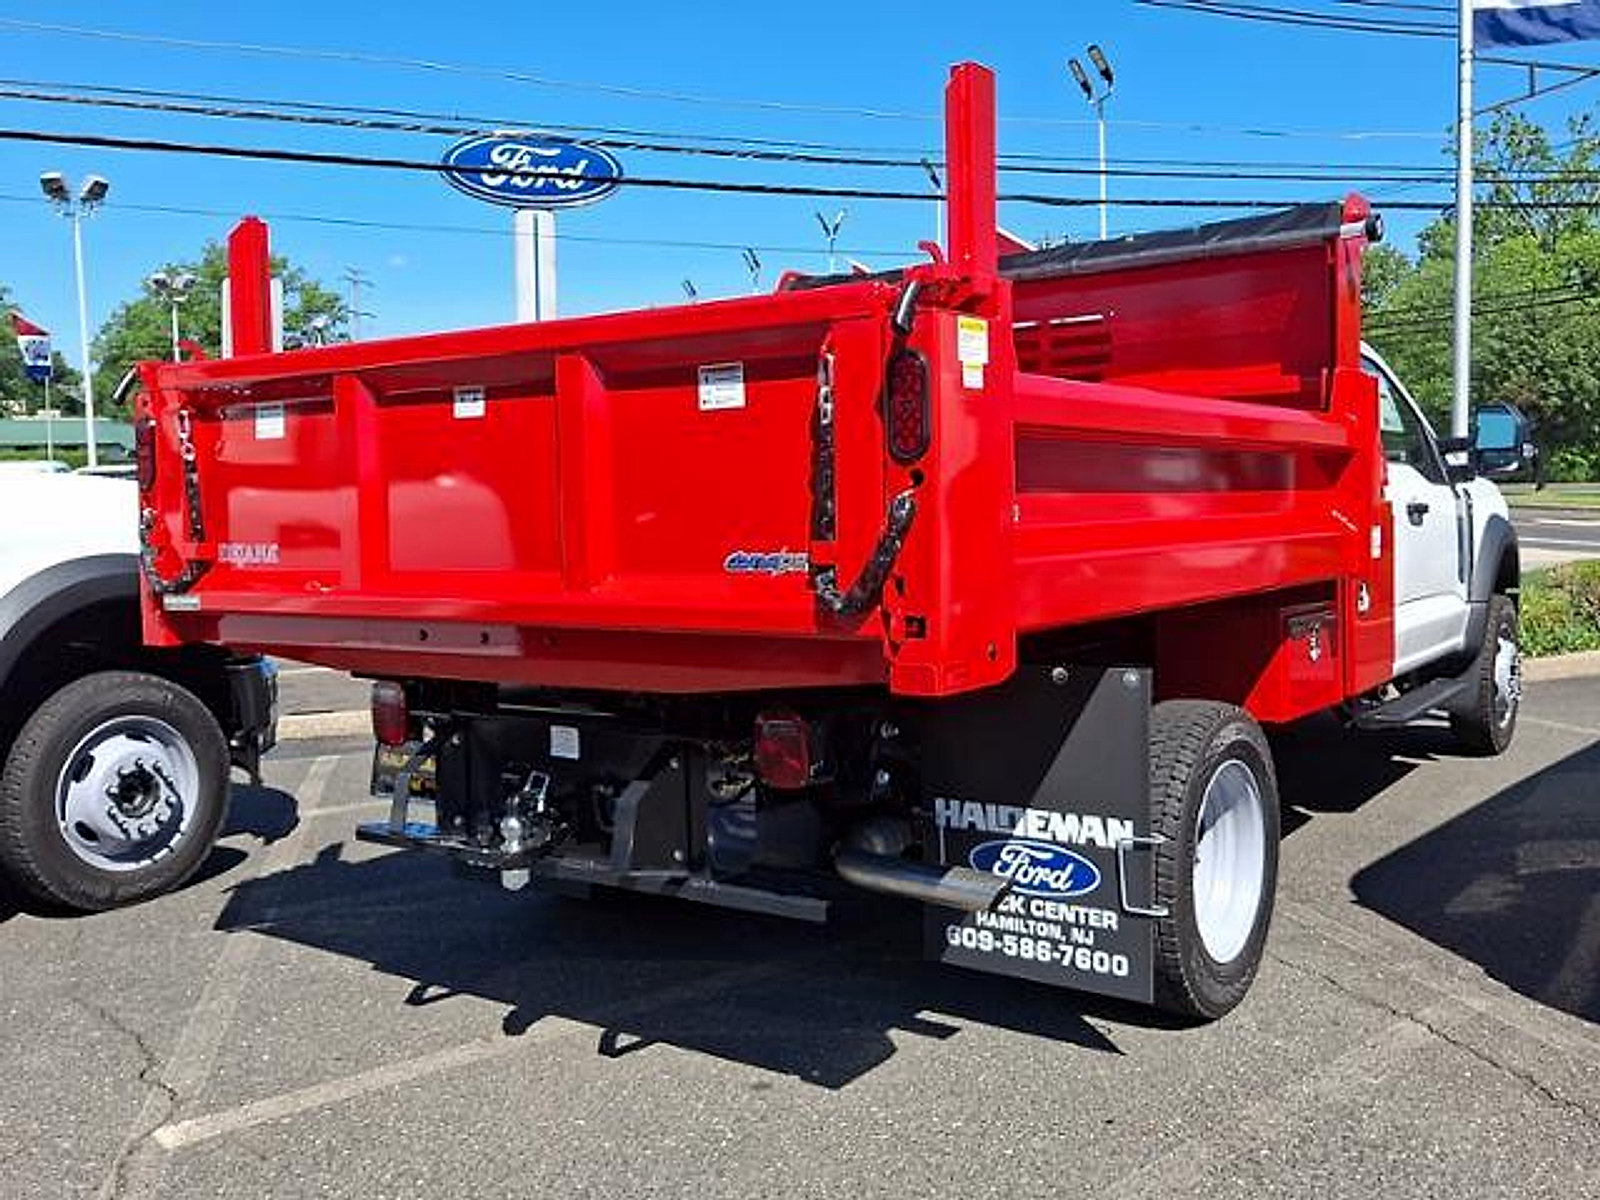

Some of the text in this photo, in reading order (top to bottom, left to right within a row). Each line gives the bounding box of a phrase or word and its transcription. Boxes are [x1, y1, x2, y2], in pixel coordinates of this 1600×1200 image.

[480, 143, 589, 189] Ford
[935, 798, 1134, 848] HALDEMAN
[992, 844, 1074, 891] Ford
[976, 910, 1094, 946] HAMILTON, NJ
[1030, 899, 1119, 931] CENTER
[946, 924, 1129, 976] 609-586-7600
